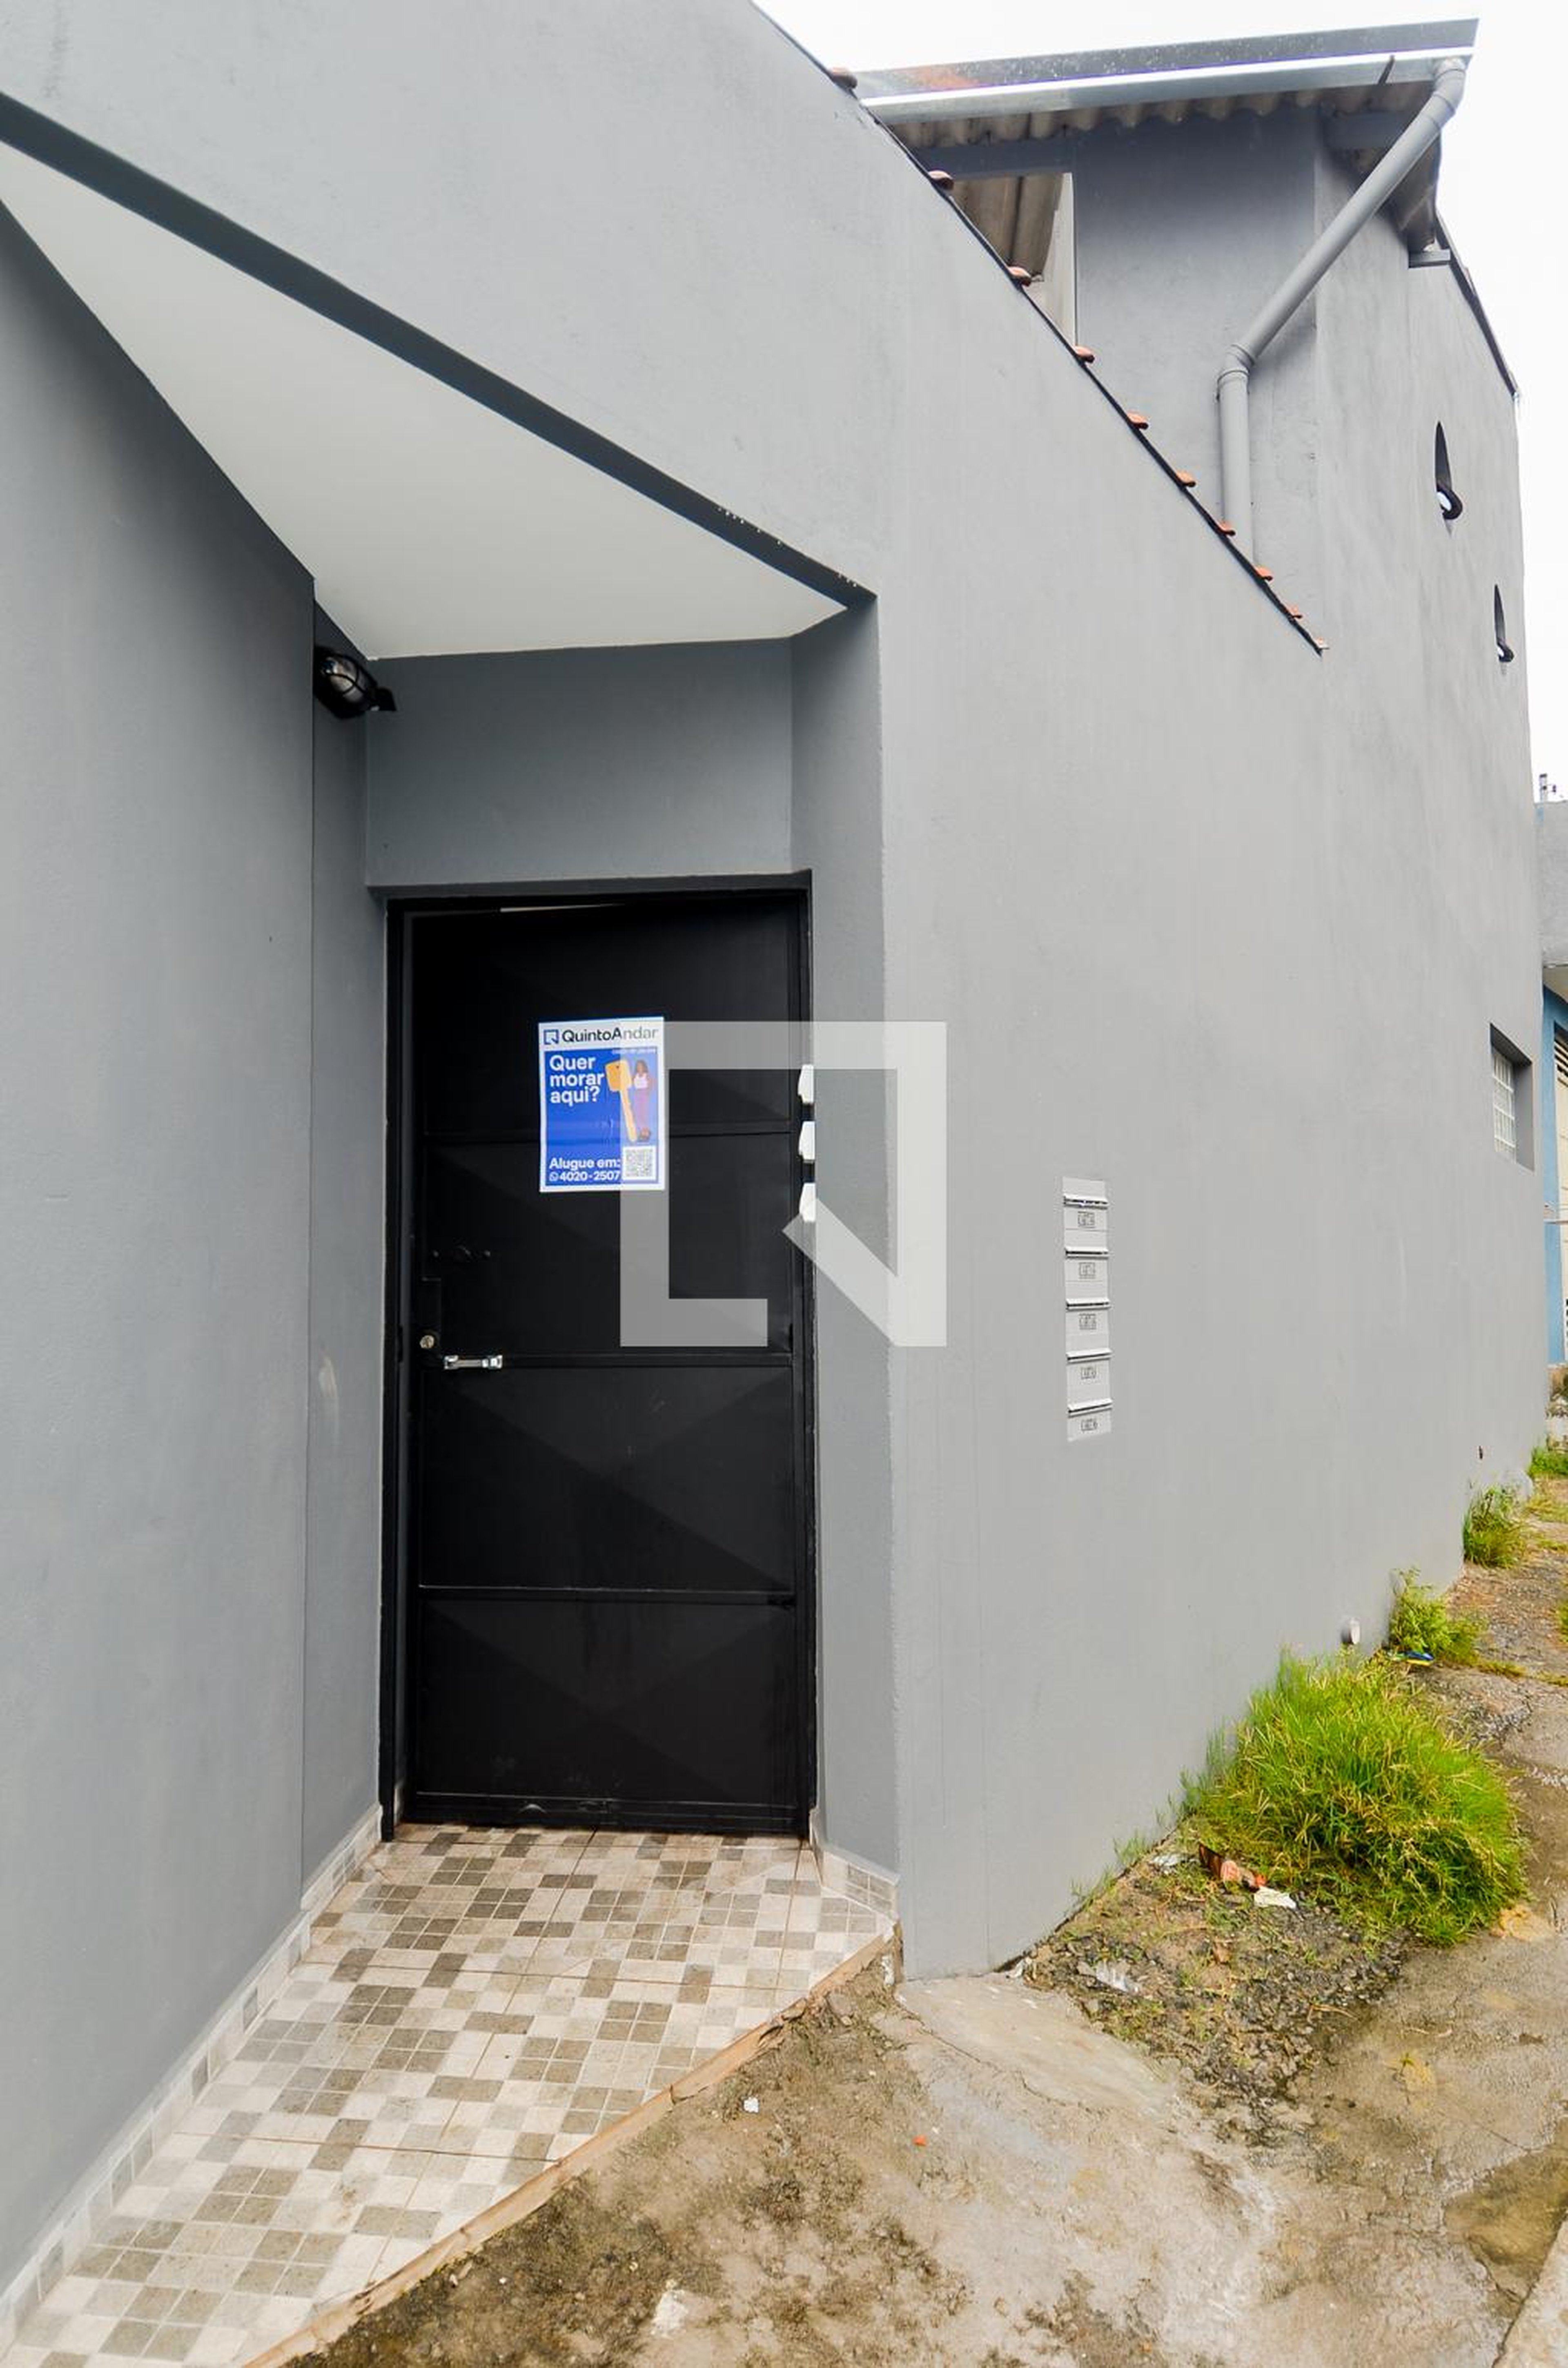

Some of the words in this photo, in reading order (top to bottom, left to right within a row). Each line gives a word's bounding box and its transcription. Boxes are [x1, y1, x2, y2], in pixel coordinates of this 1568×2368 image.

[562, 1027, 658, 1043] QuintoAndar
[549, 1055, 596, 1071] Quer
[550, 1074, 604, 1087] morar
[550, 1086, 600, 1106] aqui?
[549, 1157, 593, 1171] Alugue
[597, 1159, 620, 1168] em:
